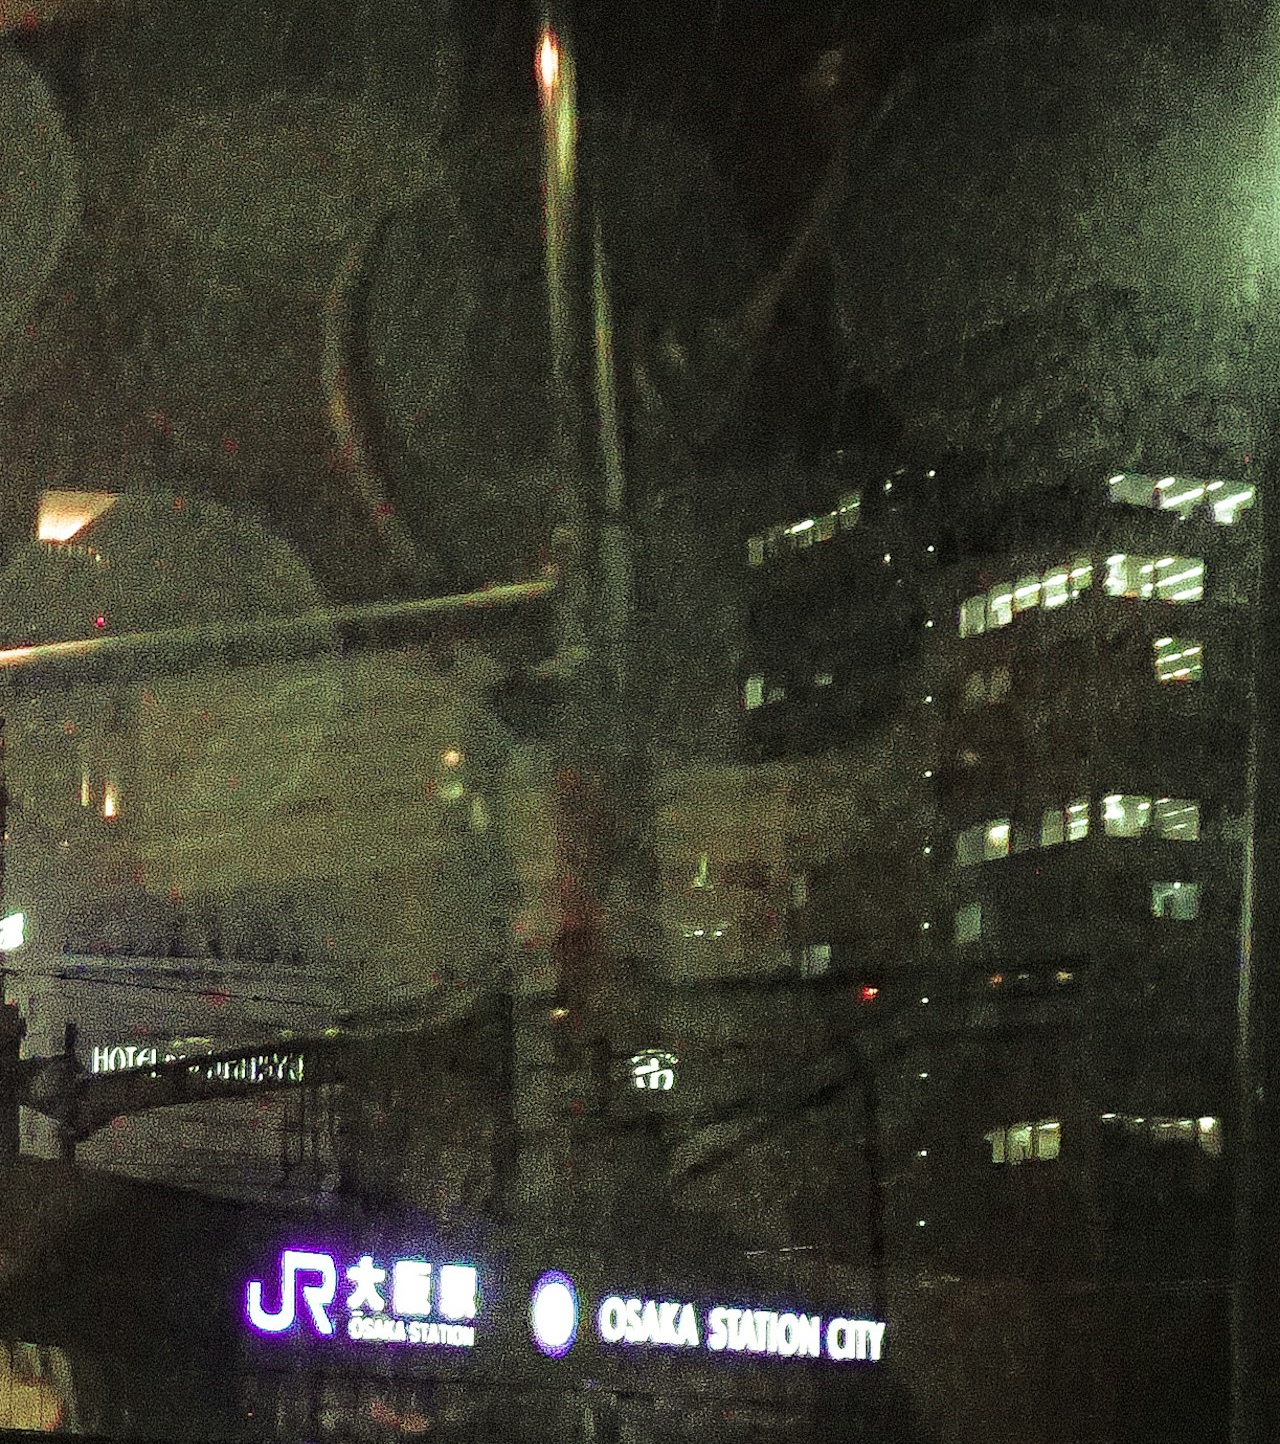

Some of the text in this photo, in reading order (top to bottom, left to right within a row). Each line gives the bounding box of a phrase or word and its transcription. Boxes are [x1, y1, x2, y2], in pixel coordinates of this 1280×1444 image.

[248, 1250, 336, 1334] JR
[409, 1321, 475, 1347] STATION
[597, 1296, 887, 1361] OSAKA STATION CITY
